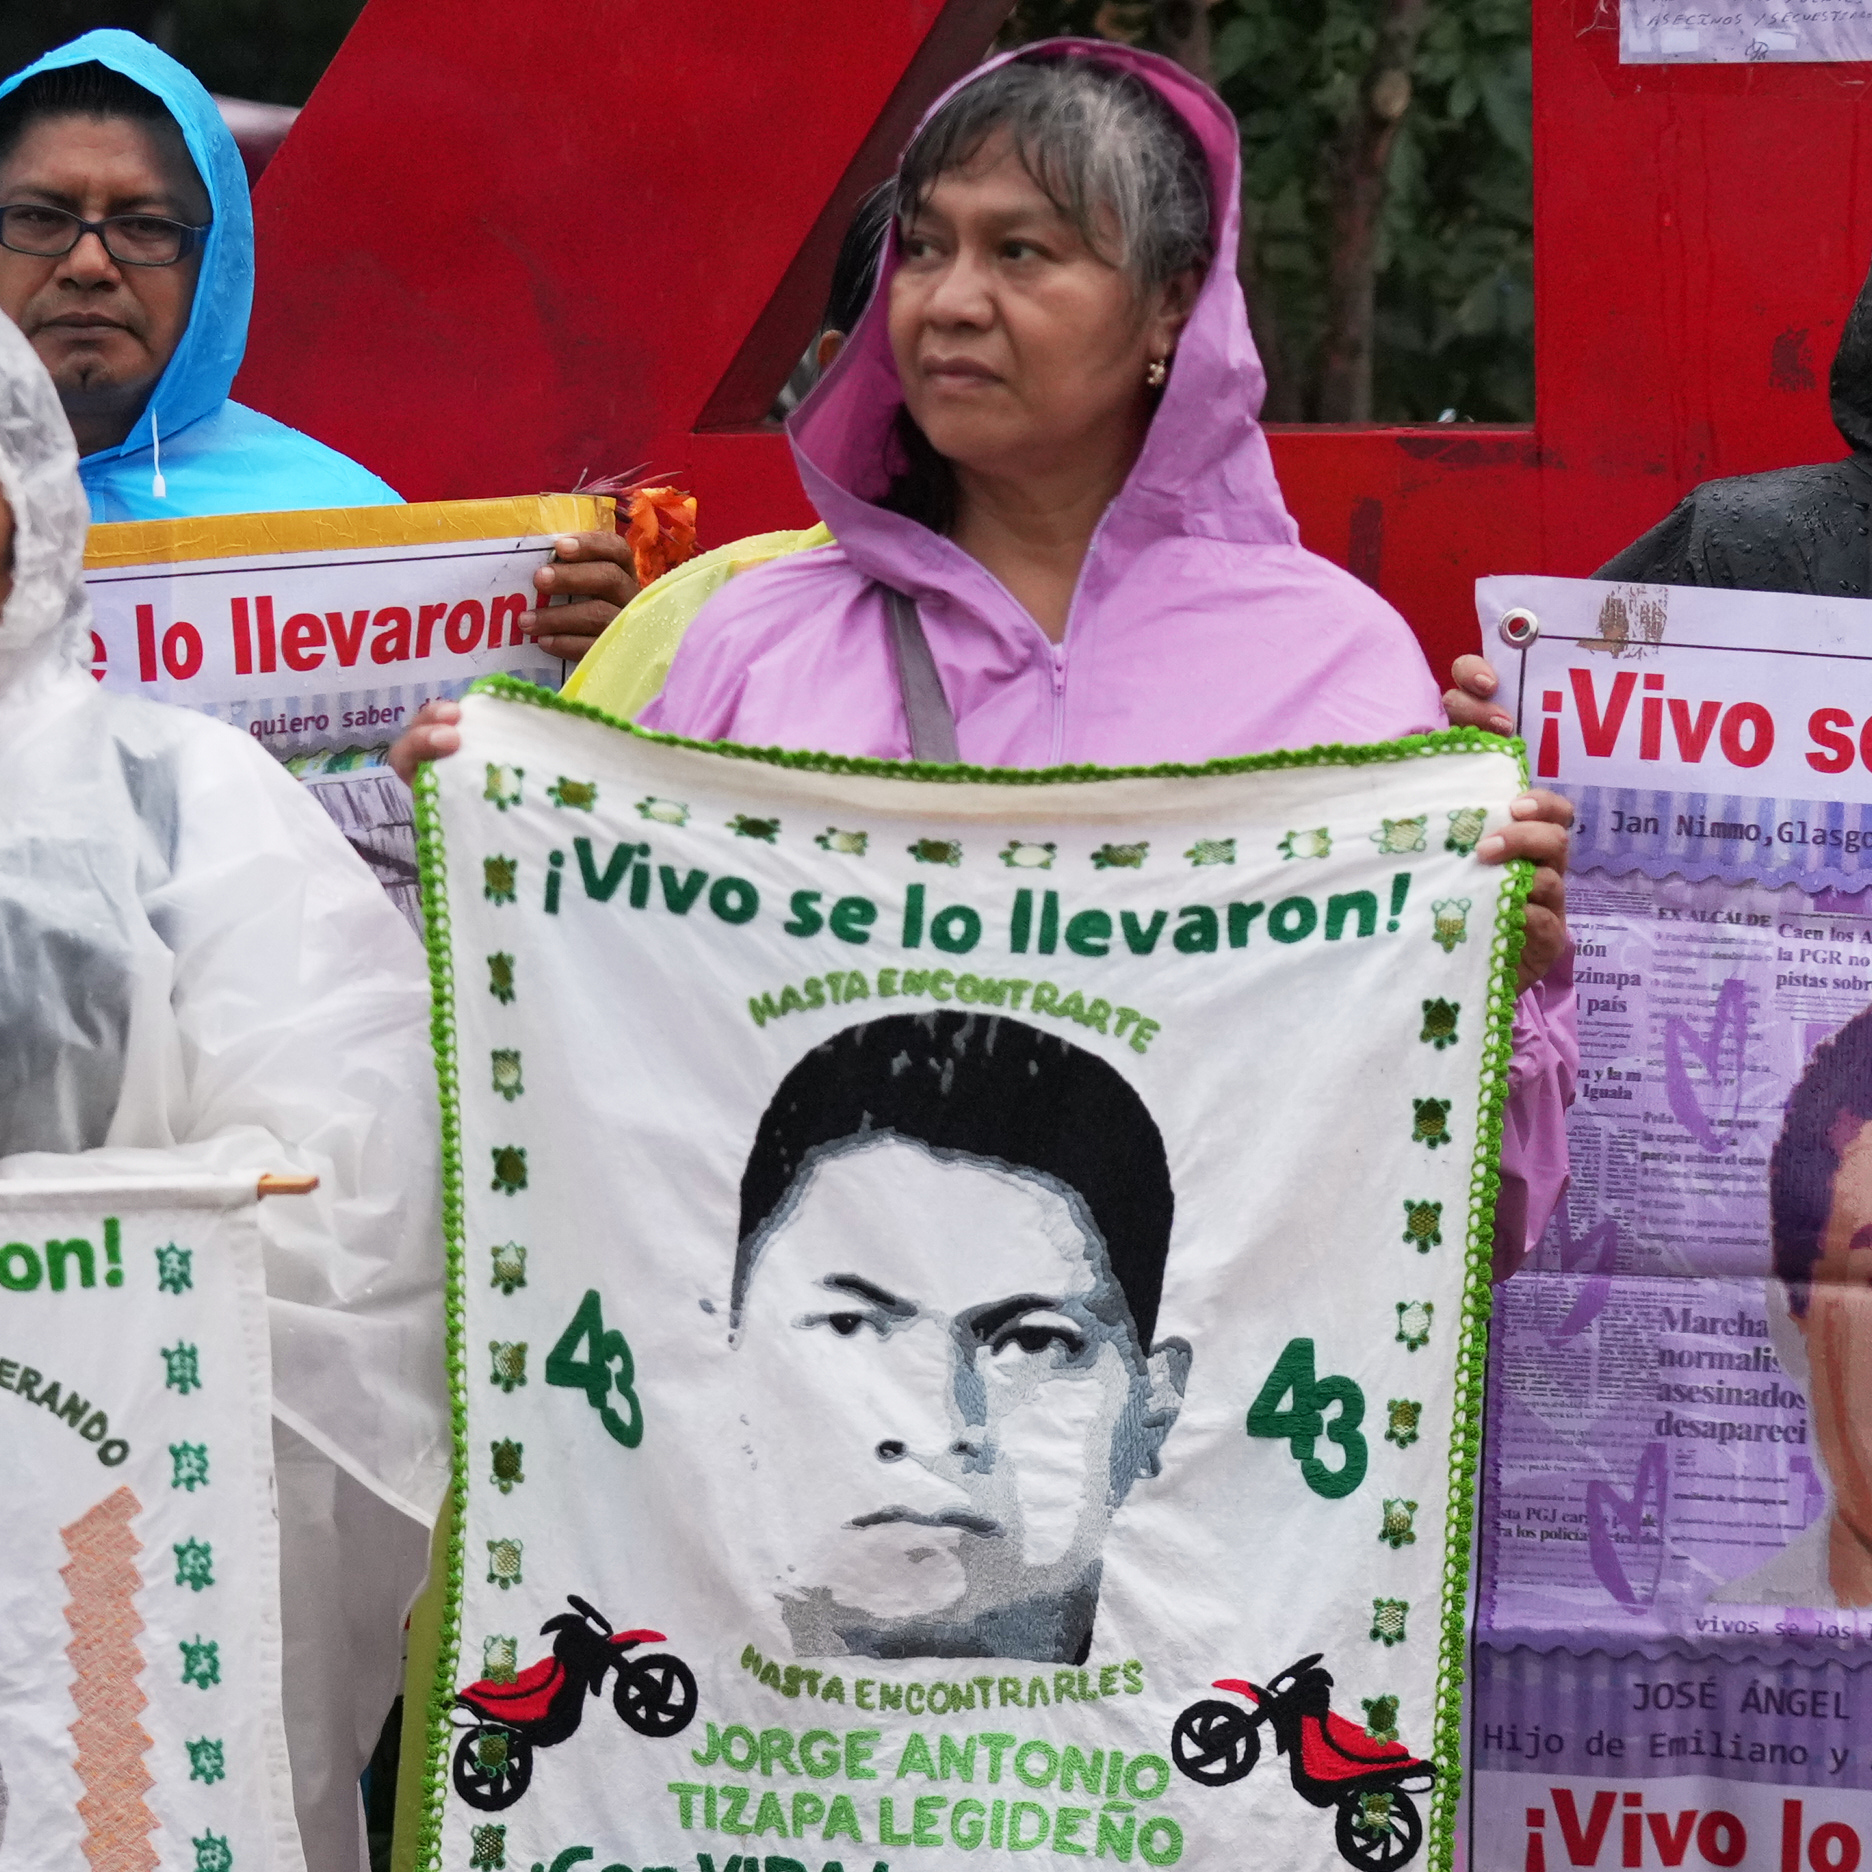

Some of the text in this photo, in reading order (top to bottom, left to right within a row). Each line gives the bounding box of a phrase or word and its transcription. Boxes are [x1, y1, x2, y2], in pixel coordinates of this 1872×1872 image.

[135, 603, 204, 682] lo
[250, 713, 330, 739] quiero
[342, 704, 405, 728] saber
[1537, 667, 1775, 778] ¡Vivo
[1610, 810, 1660, 835] Jan
[543, 837, 1411, 957] ¡Vivo se lo llevaron!
[1778, 923, 1824, 940] Caen
[1830, 927, 1854, 943] los
[1799, 948, 1870, 968] PGR no
[1776, 971, 1828, 990] pistas
[877, 967, 1161, 1056] ENCONTRARTE
[1660, 1307, 1769, 1338] Marcha
[545, 1288, 644, 1449] 43
[1246, 1337, 1368, 1499] 43
[1695, 1616, 1759, 1636] vivos
[1774, 1622, 1800, 1638] se
[855, 1659, 1144, 1716] ENCONTRARLES
[1633, 1675, 1718, 1712] JOSÉ
[1739, 1678, 1850, 1720] ÁNGEL
[691, 1722, 1171, 1801] JORGE ANTONIO
[1483, 1723, 1565, 1760] Hijo
[1585, 1730, 1625, 1758] de
[1649, 1731, 1809, 1766] Emiliano
[1828, 1746, 1850, 1776] y
[667, 1781, 1185, 1868] TIZAPA LEGIDEÑO
